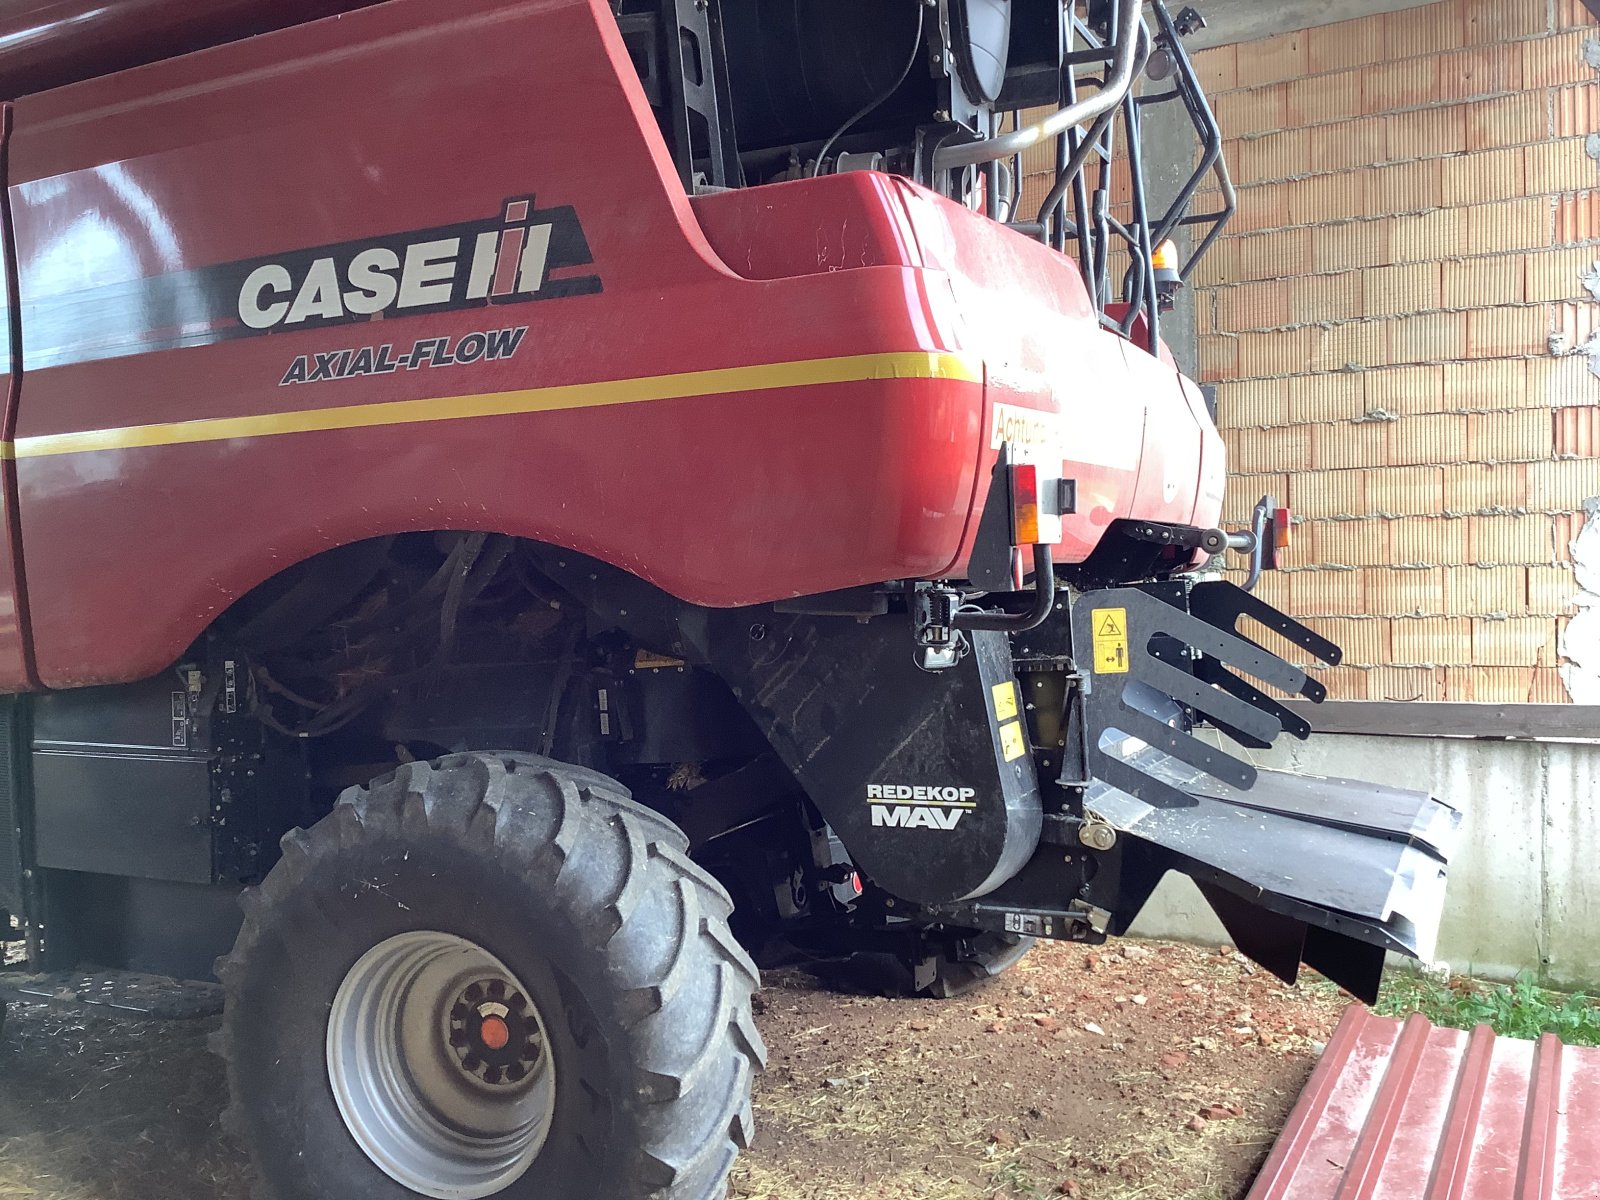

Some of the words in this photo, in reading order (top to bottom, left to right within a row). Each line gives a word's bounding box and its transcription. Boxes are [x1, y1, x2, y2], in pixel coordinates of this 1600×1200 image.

[237, 236, 462, 330] CASE
[278, 326, 529, 386] AXIAL-FLOW
[867, 785, 975, 801] REDEKOP
[871, 806, 964, 830] MAV
